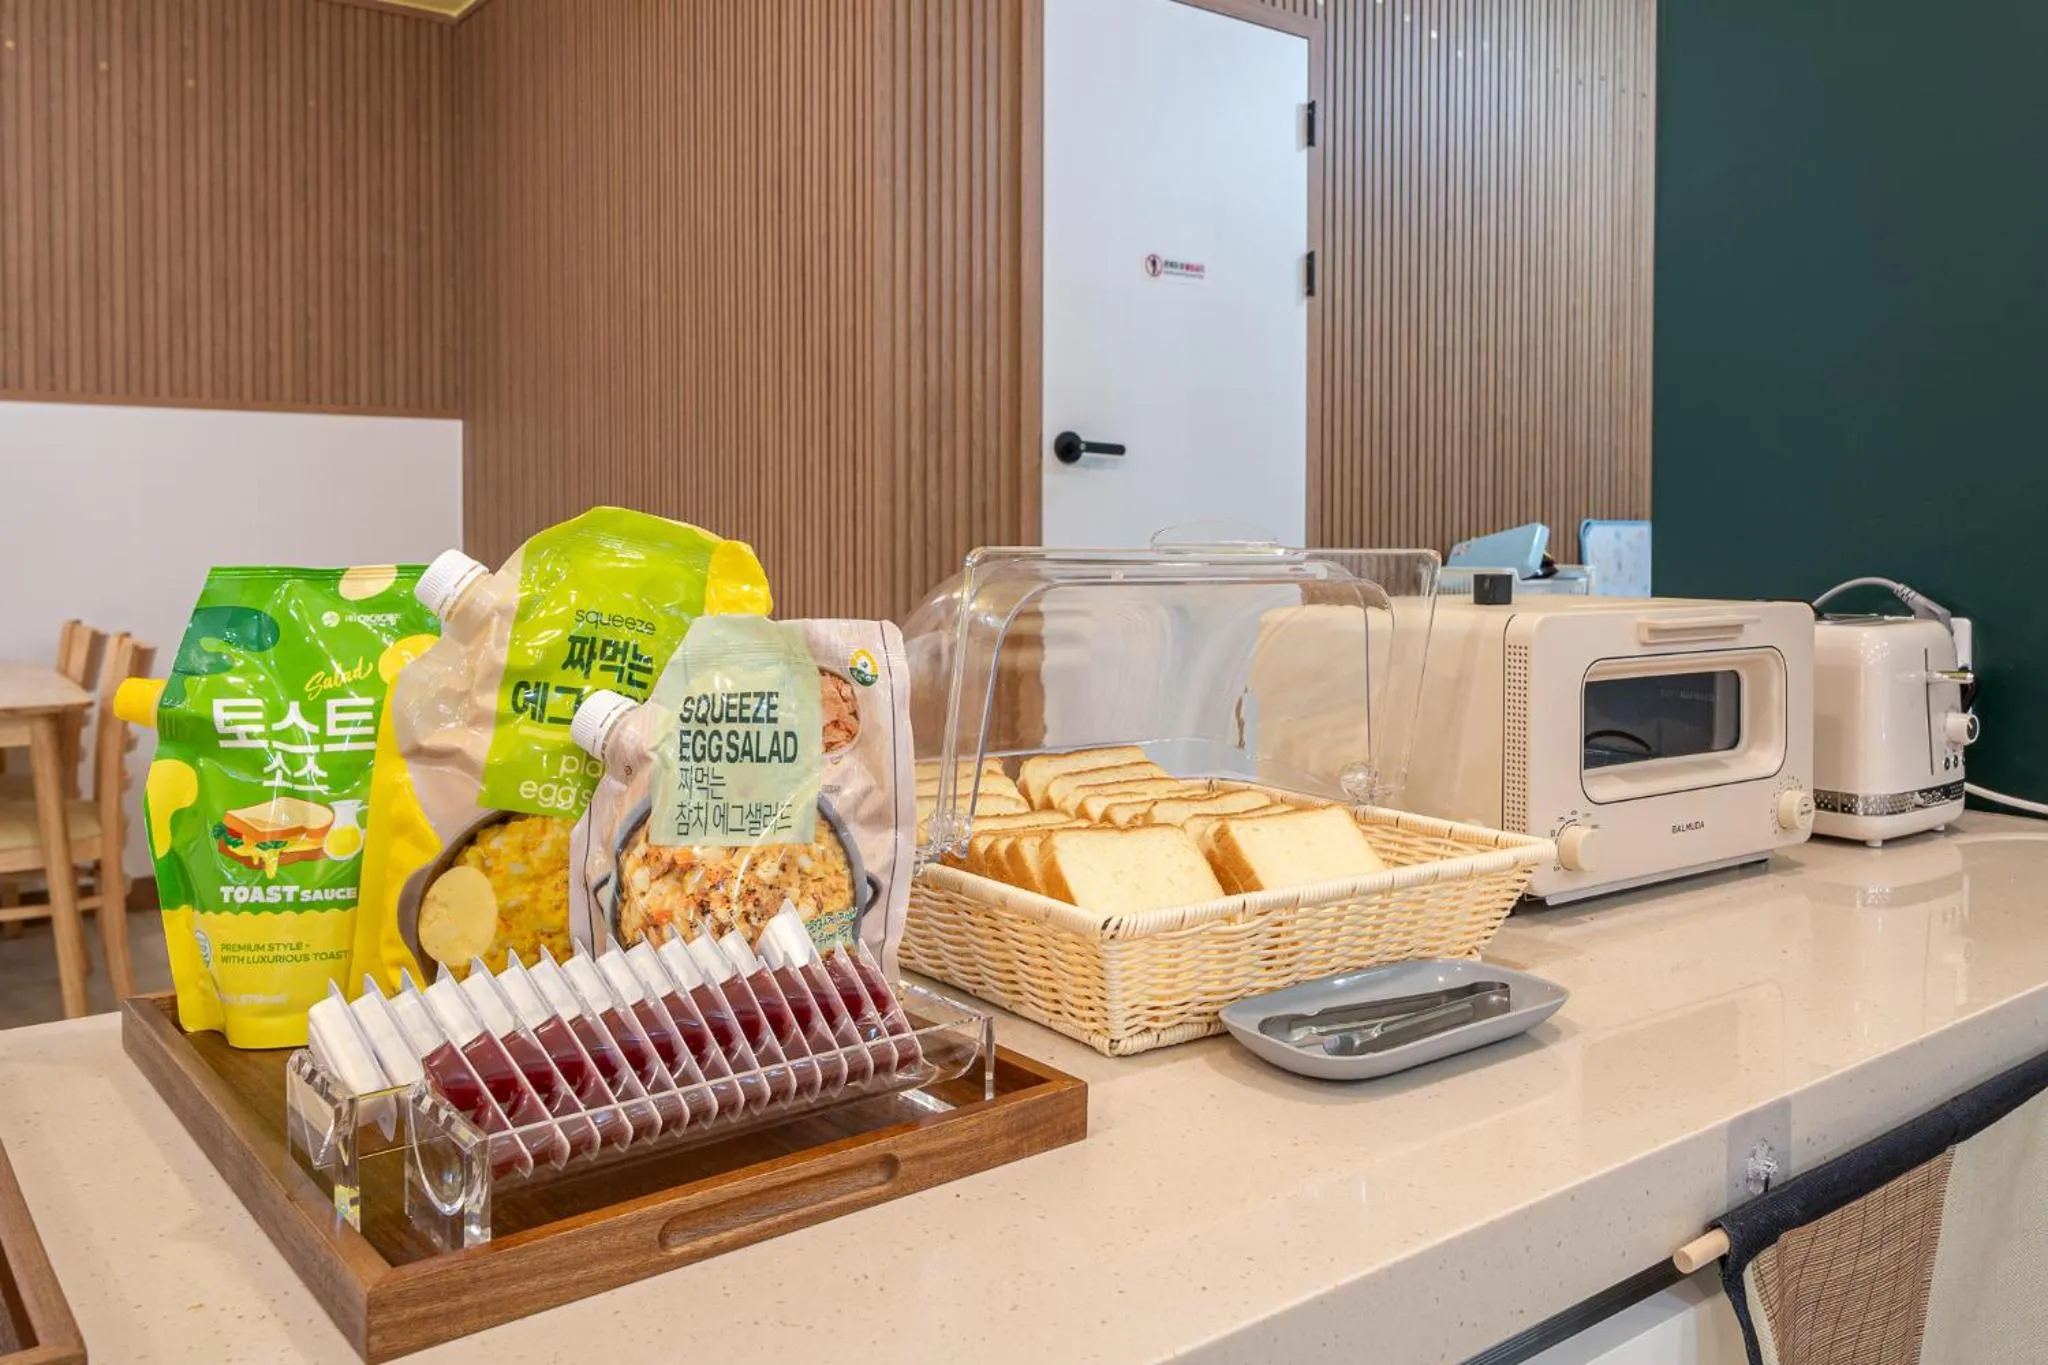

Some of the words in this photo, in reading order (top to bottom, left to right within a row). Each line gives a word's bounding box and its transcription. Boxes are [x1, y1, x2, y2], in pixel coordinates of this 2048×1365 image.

[574, 609, 656, 635] squeeze
[304, 656, 373, 700] Salad
[561, 634, 653, 689] 짜먹는
[212, 697, 377, 753] 토스트
[679, 691, 779, 726] SQUEEZE
[262, 751, 331, 791] 소스
[678, 765, 726, 800] 짜먹는
[675, 801, 708, 836] 참치
[712, 801, 793, 837] 에그샐러드
[1671, 820, 1705, 835] BALMUDA
[220, 885, 300, 904] TOAST
[300, 887, 357, 902] SAUCE
[220, 943, 265, 953] PREMIUM
[267, 942, 303, 952] STYLE
[221, 955, 245, 965] WITH
[246, 953, 310, 965] LUXURIOUS
[313, 950, 350, 961] TOAST
